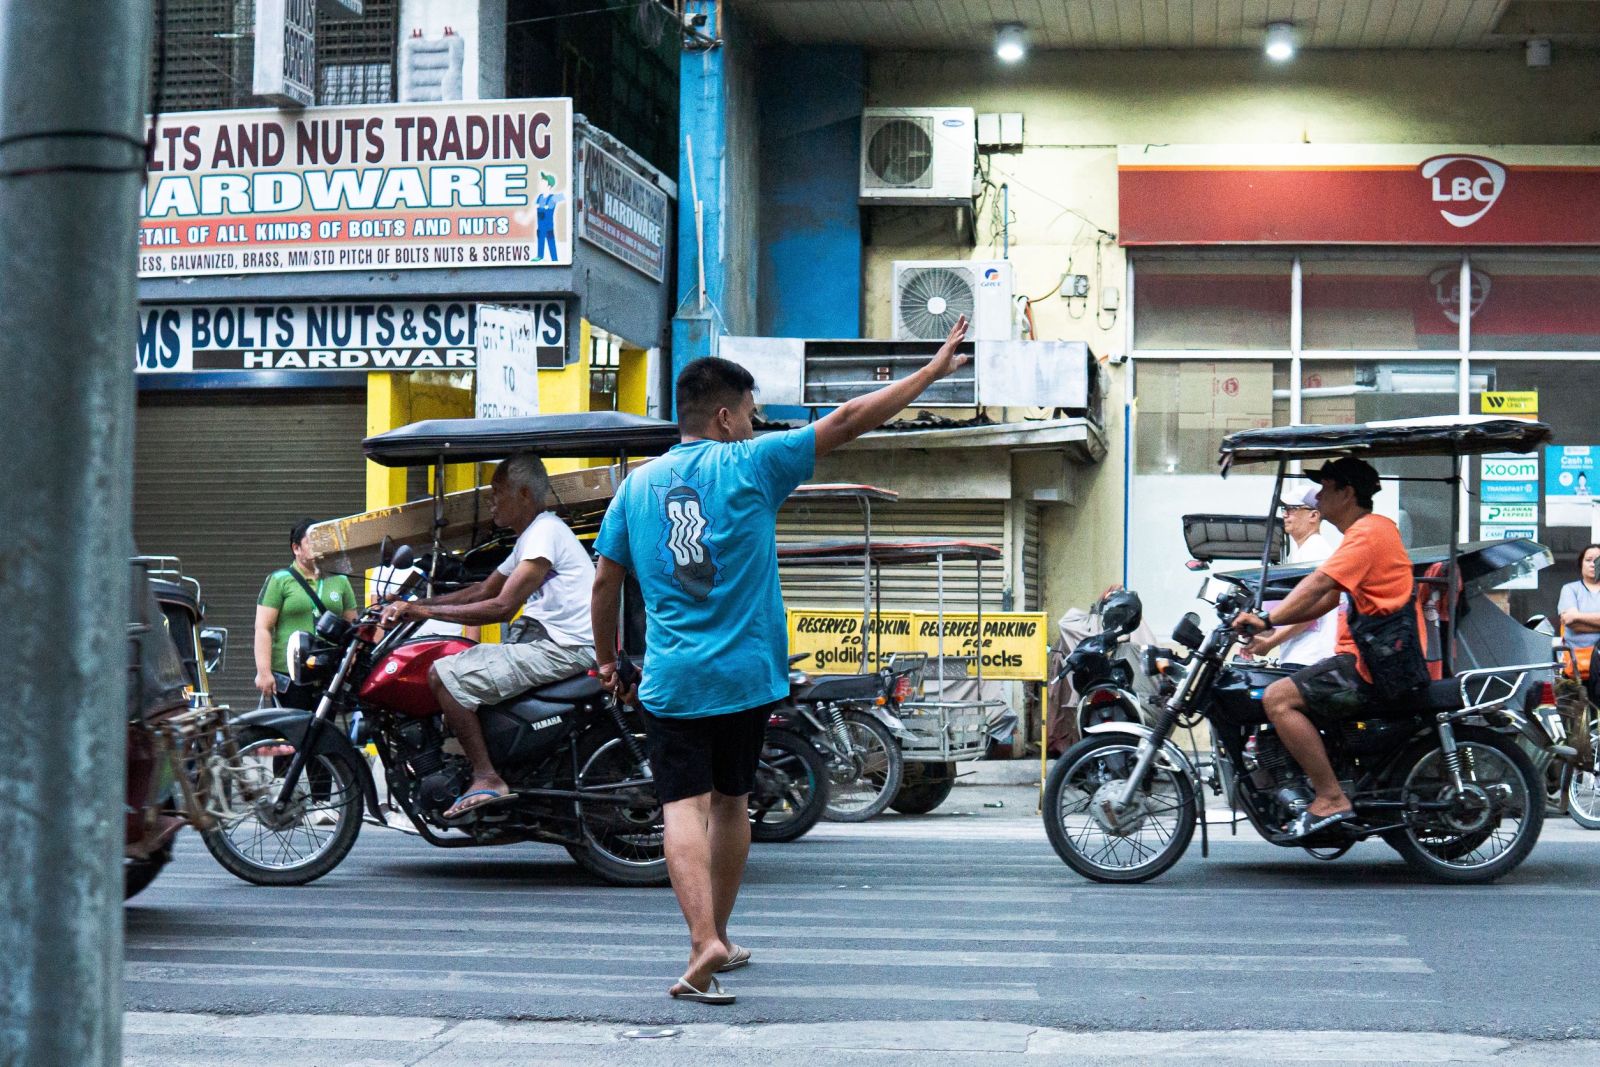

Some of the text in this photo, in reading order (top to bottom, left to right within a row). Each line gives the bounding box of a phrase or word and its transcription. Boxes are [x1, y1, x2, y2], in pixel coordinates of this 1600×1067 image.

[211, 122, 285, 169] AND
[296, 117, 385, 166] NUTS
[395, 112, 551, 162] TRADING
[138, 164, 528, 218] ARDWARE
[1432, 176, 1496, 202] LBC
[187, 224, 210, 245] OF
[216, 223, 249, 243] ALL
[255, 221, 312, 241] KINDS
[319, 219, 342, 239] OF
[348, 218, 406, 238] BOLTS
[413, 217, 452, 237] AND
[458, 216, 509, 235] NUTS
[604, 191, 661, 247] HARDWARE
[171, 252, 238, 271] GALVANIZED,
[243, 251, 283, 268] BRASS,
[340, 248, 372, 265] PITCH
[377, 248, 390, 264] OF
[395, 247, 429, 264] BOLTS
[434, 246, 464, 263] NUTS
[469, 246, 478, 262] &
[483, 244, 530, 262] SCREWS
[191, 306, 294, 348] BOLTS
[243, 349, 476, 369] HARDWAR
[503, 366, 515, 392] TO
[1485, 464, 1536, 476] xoom
[796, 617, 857, 633] RESERVED
[983, 621, 1037, 638] PARKING
[841, 636, 870, 645] FO
[531, 715, 562, 731] YAMAHA
